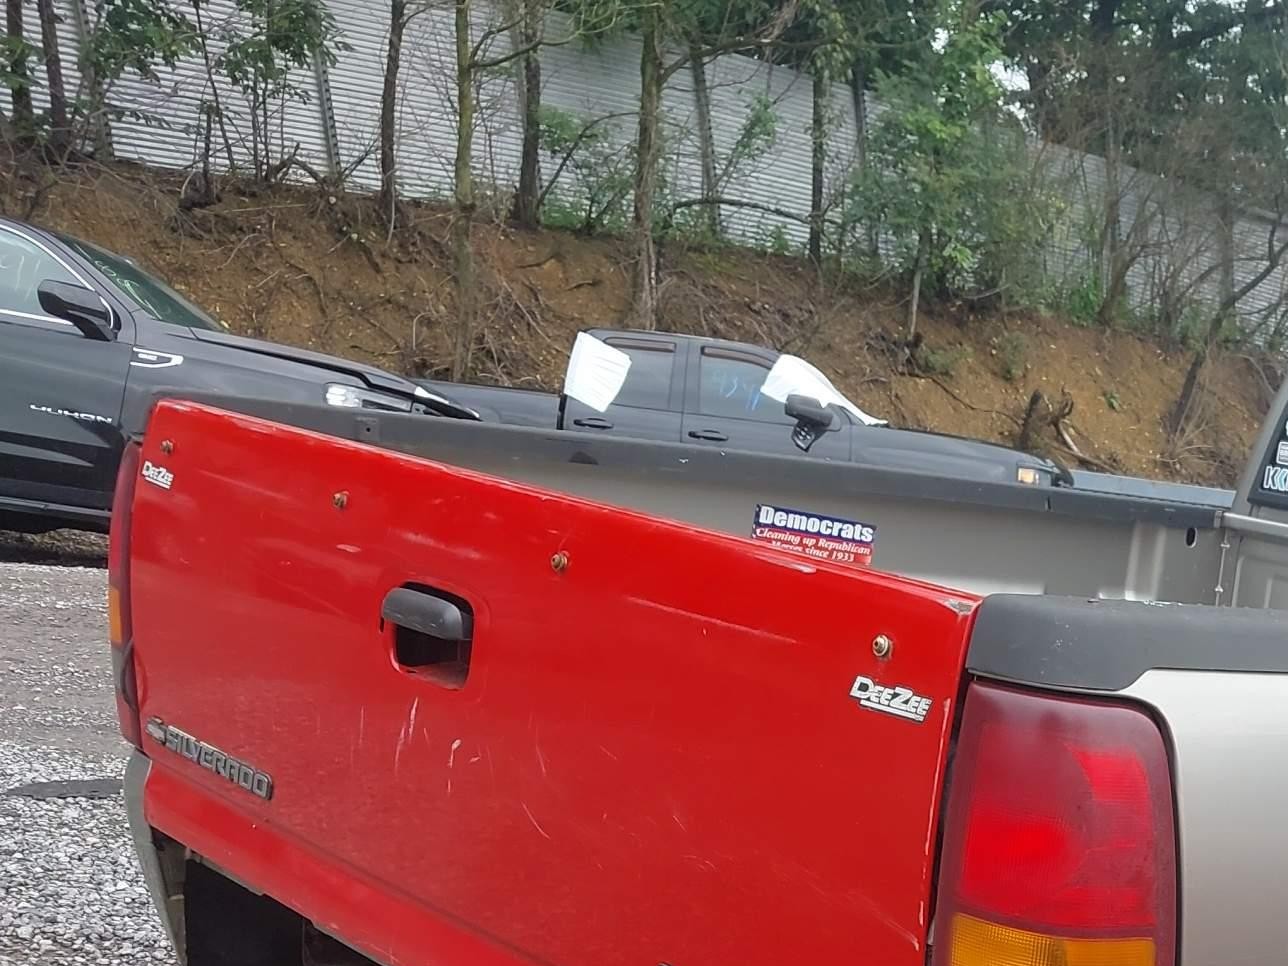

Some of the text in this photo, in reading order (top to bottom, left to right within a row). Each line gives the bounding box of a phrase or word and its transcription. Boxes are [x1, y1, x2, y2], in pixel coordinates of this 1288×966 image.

[30, 404, 112, 424] YUKON
[758, 505, 874, 542] Democrats
[756, 527, 871, 554] Cleaning up Republican
[805, 547, 829, 558] since
[831, 550, 855, 563] 1933
[166, 724, 273, 801] SILVERADO
